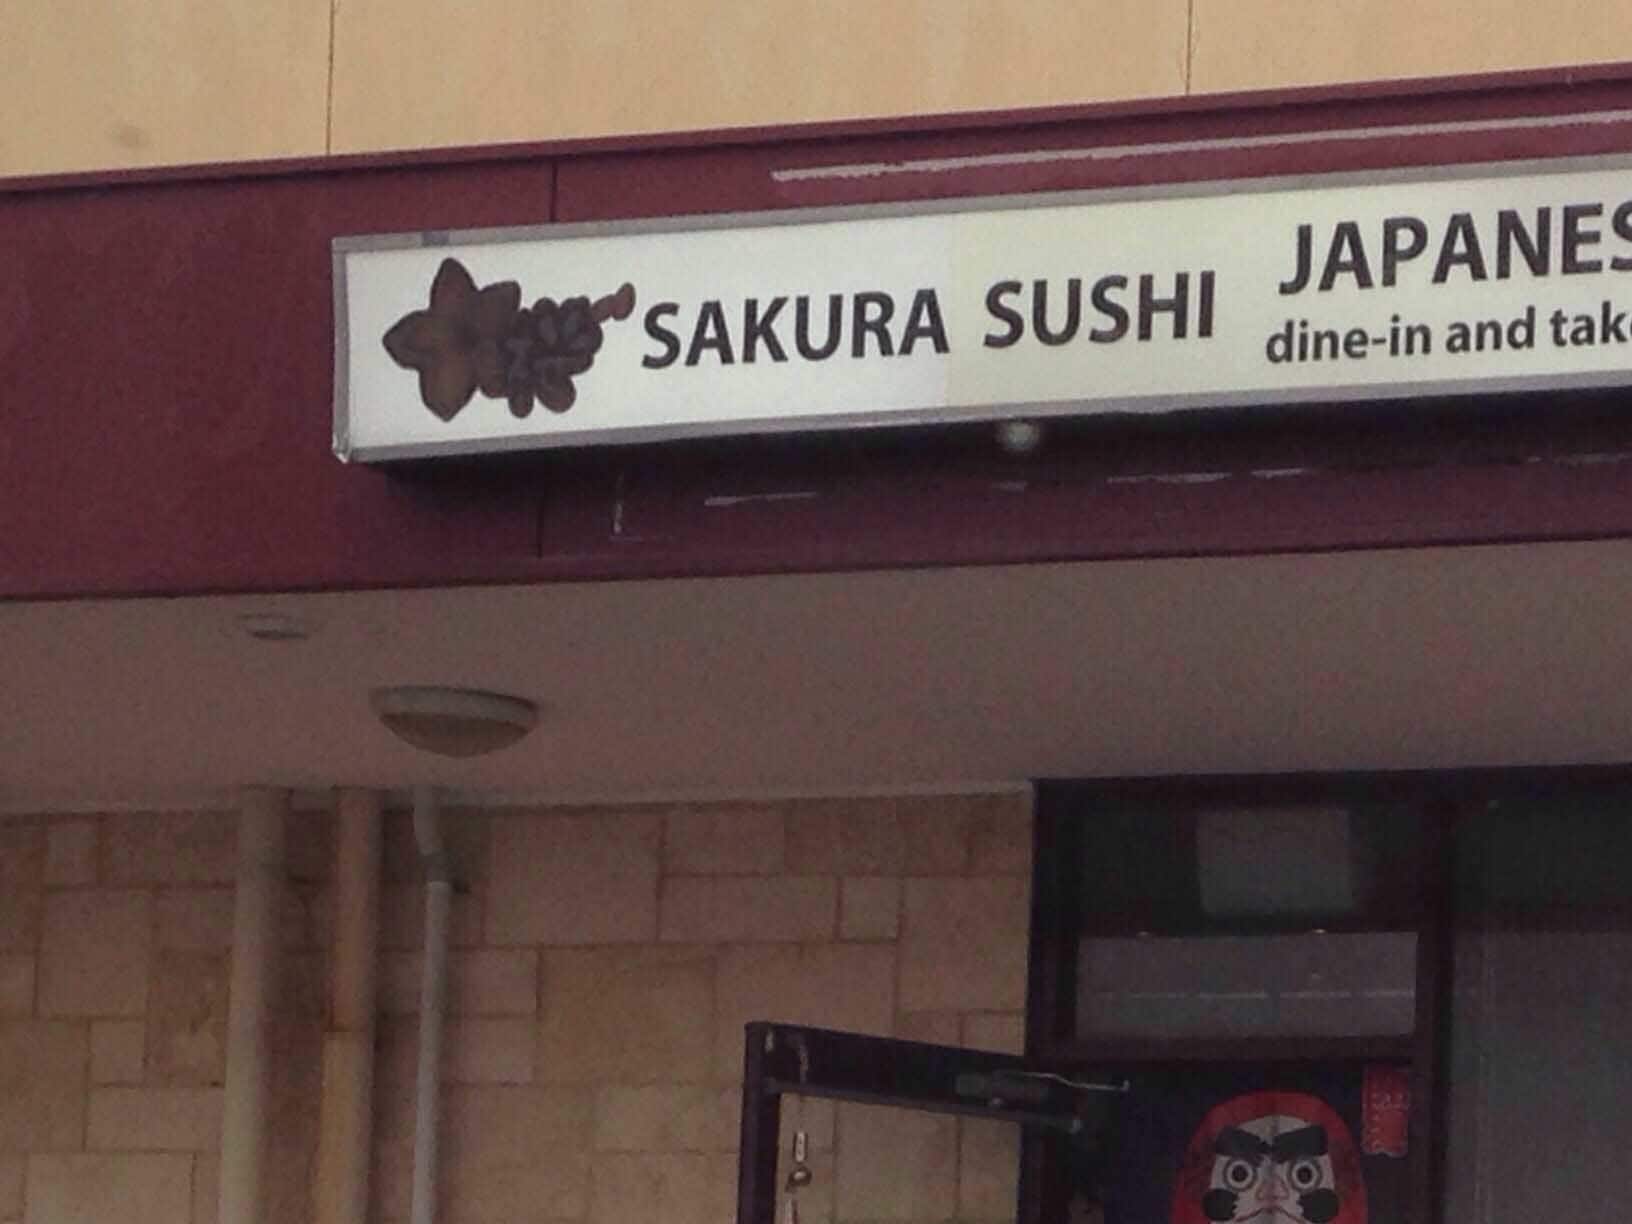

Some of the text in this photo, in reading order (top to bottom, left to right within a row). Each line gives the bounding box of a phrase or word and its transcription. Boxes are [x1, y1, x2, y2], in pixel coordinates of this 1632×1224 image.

[641, 270, 1215, 369] SAKURA SUSHI
[1266, 312, 1432, 364] dine-in
[1444, 302, 1536, 356] and
